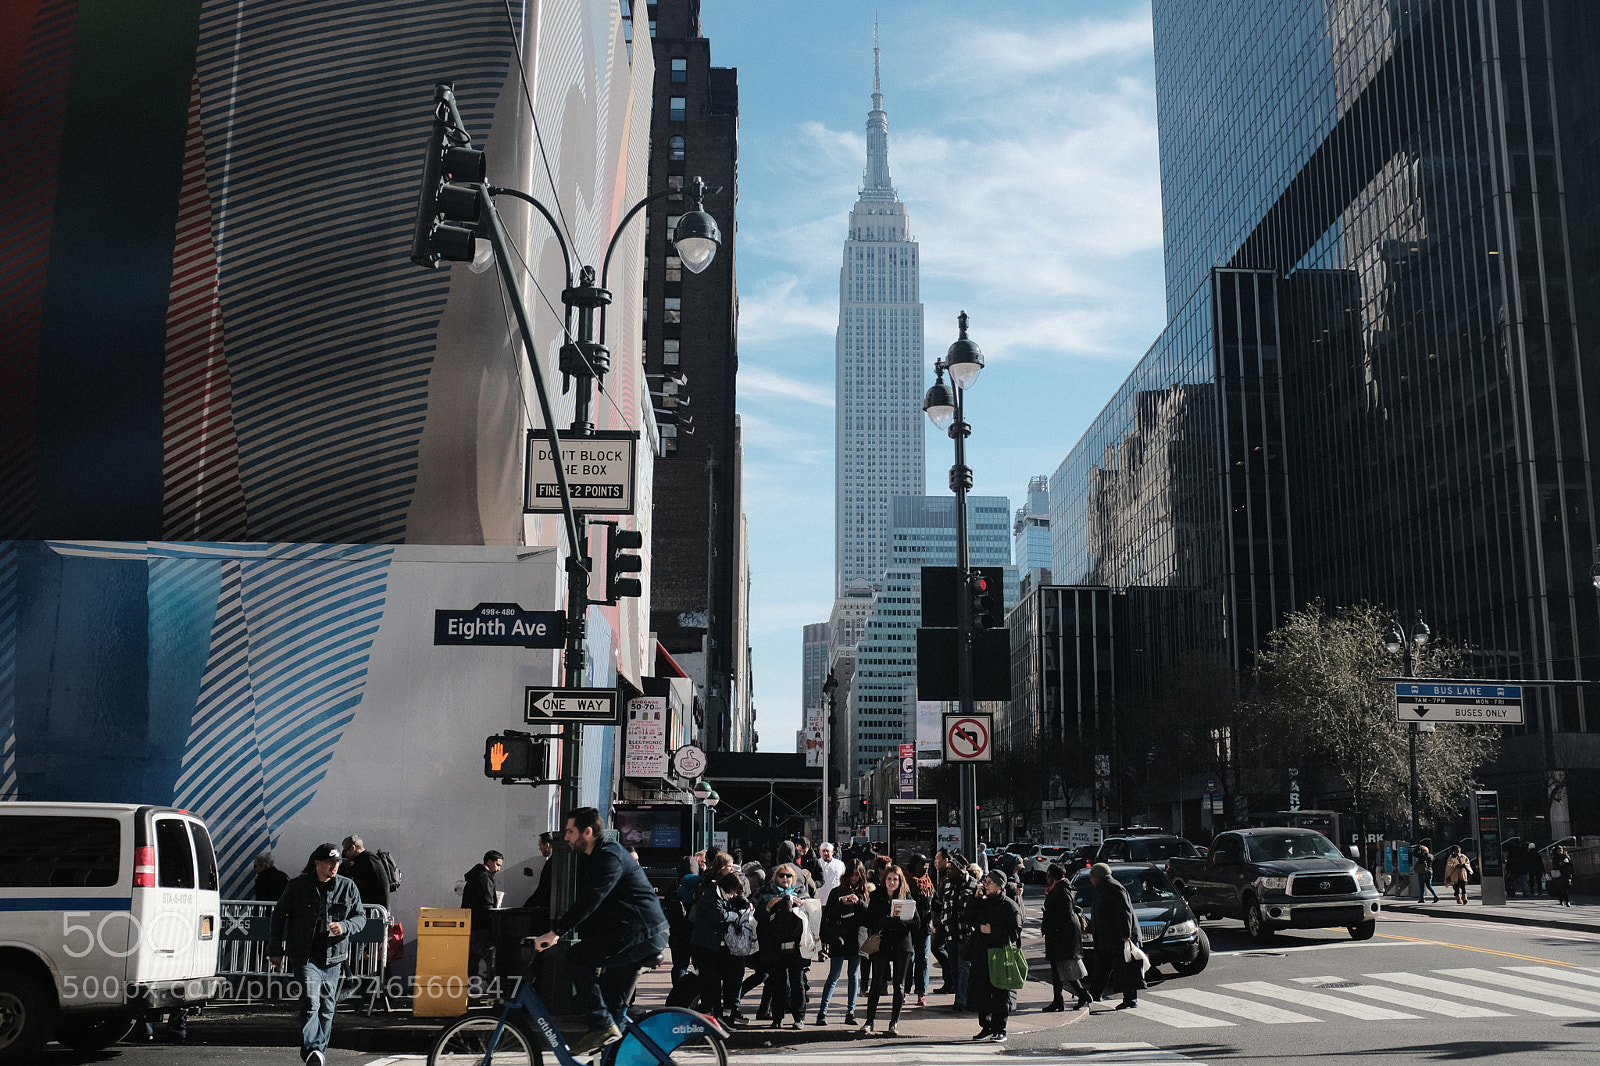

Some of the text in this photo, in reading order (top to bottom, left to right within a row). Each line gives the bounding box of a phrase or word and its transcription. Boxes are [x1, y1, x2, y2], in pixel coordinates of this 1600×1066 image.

[538, 450, 622, 461] DO'T BLOCK
[564, 464, 607, 475] HE BOX
[539, 485, 560, 496] FINE
[585, 486, 620, 497] POINTS
[480, 608, 516, 616] 498 480
[447, 618, 547, 640] Eighth Ave
[1433, 686, 1482, 696] BUS LANE
[542, 699, 604, 711] ONE WAY
[1455, 708, 1507, 718] BUSES ONLY
[938, 834, 960, 842] FedEx
